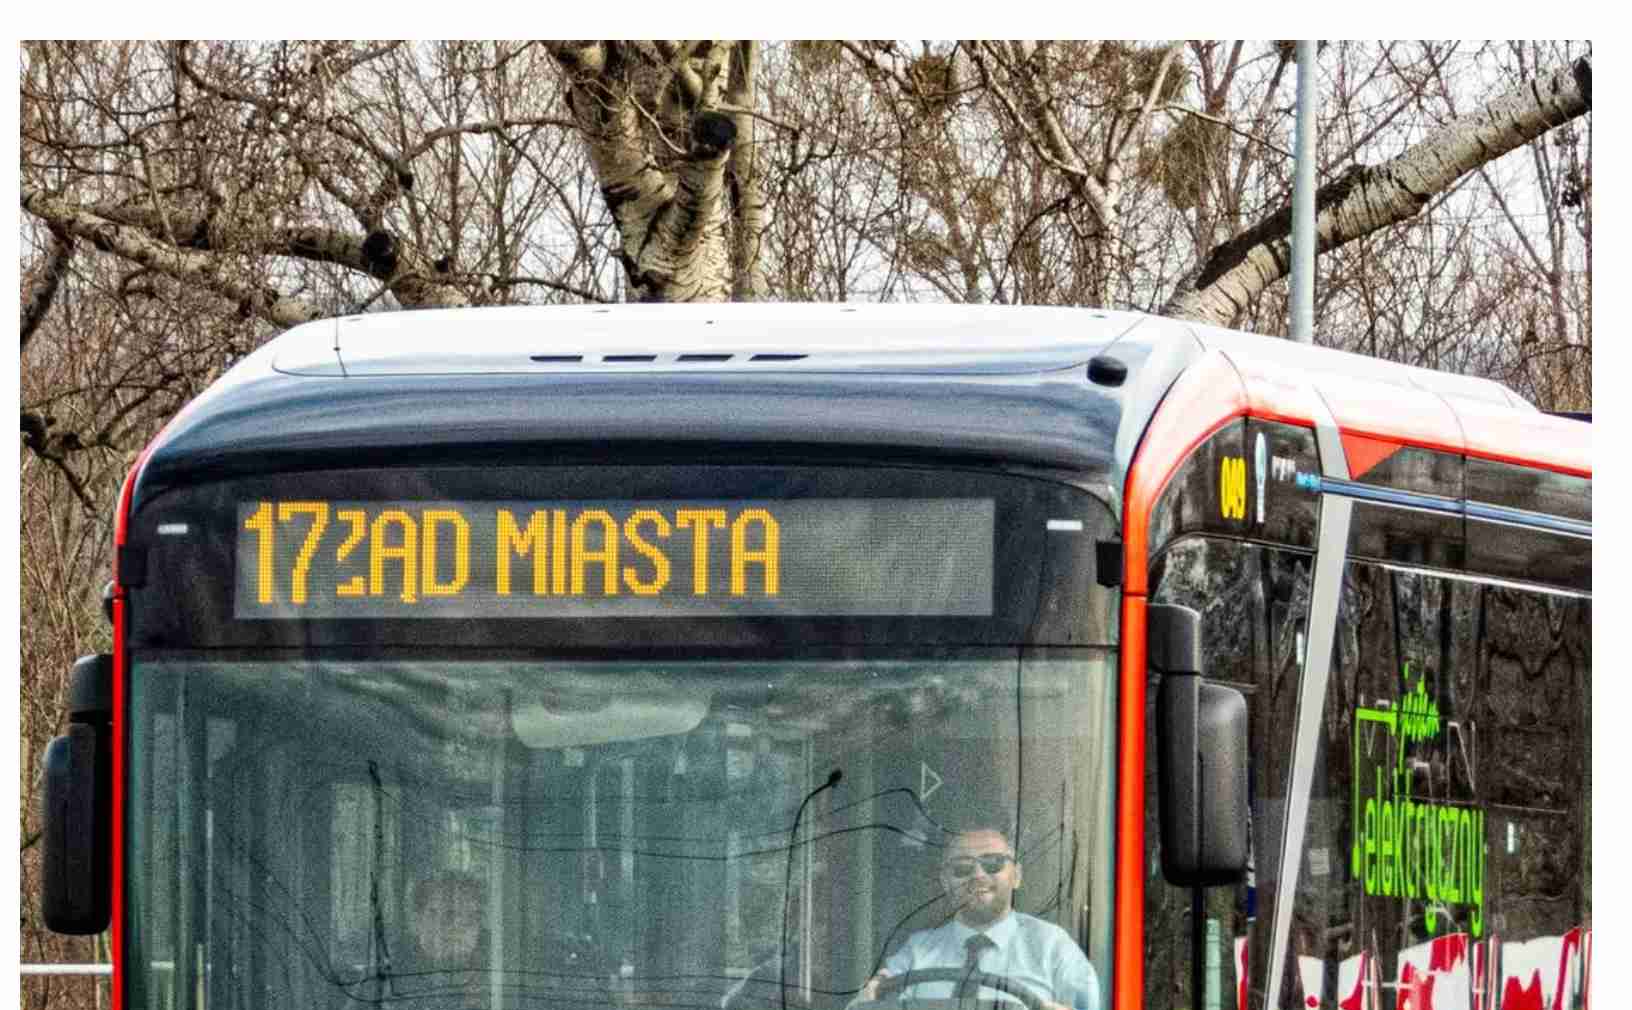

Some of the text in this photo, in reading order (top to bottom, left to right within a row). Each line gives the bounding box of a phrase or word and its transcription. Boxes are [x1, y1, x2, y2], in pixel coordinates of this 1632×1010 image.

[1221, 456, 1246, 520] 049
[244, 503, 328, 603] 17
[496, 509, 780, 595] MIASTA
[1365, 765, 1484, 938] elektryczny
